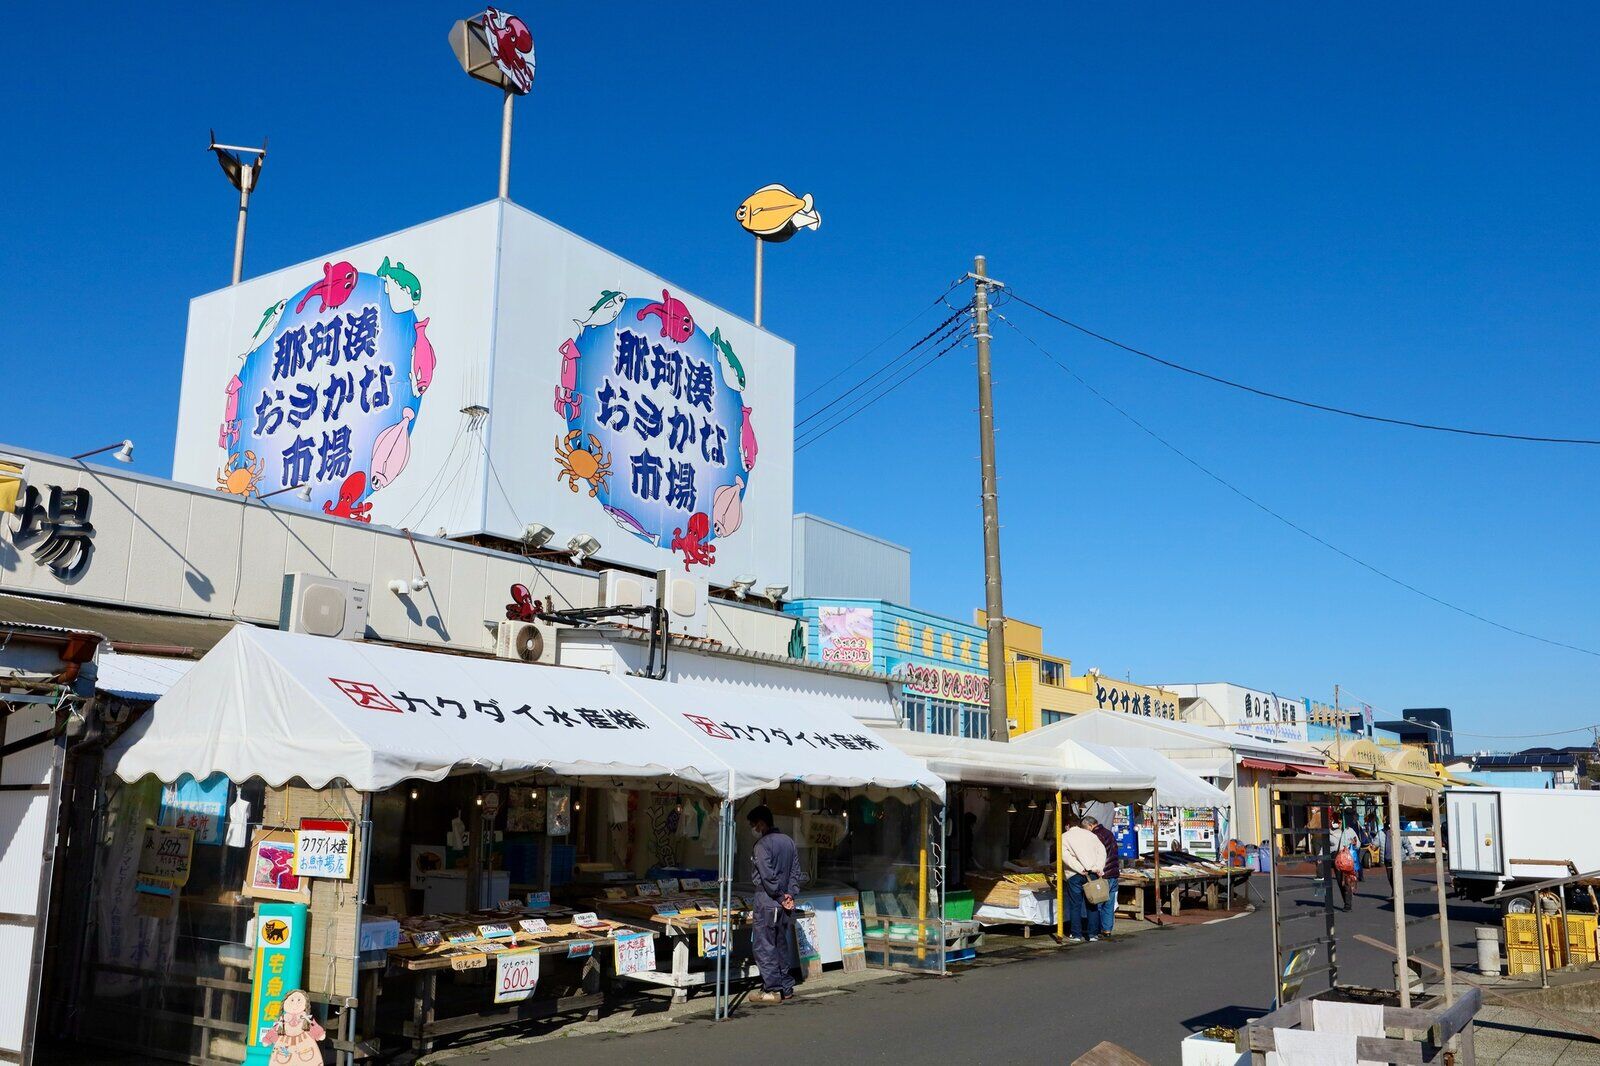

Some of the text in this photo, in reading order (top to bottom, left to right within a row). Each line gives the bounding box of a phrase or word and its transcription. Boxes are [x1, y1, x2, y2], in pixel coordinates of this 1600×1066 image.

[271, 307, 380, 382] 那珂湊
[614, 329, 714, 414] 那珂湊
[254, 364, 394, 436] おさかな
[595, 378, 728, 468] おさかな
[280, 424, 354, 488] 市場
[628, 448, 698, 514] 市場
[1095, 682, 1152, 718] ヤマサ水産
[302, 837, 348, 854] カクダイ水産
[263, 953, 287, 1021] 宅急便
